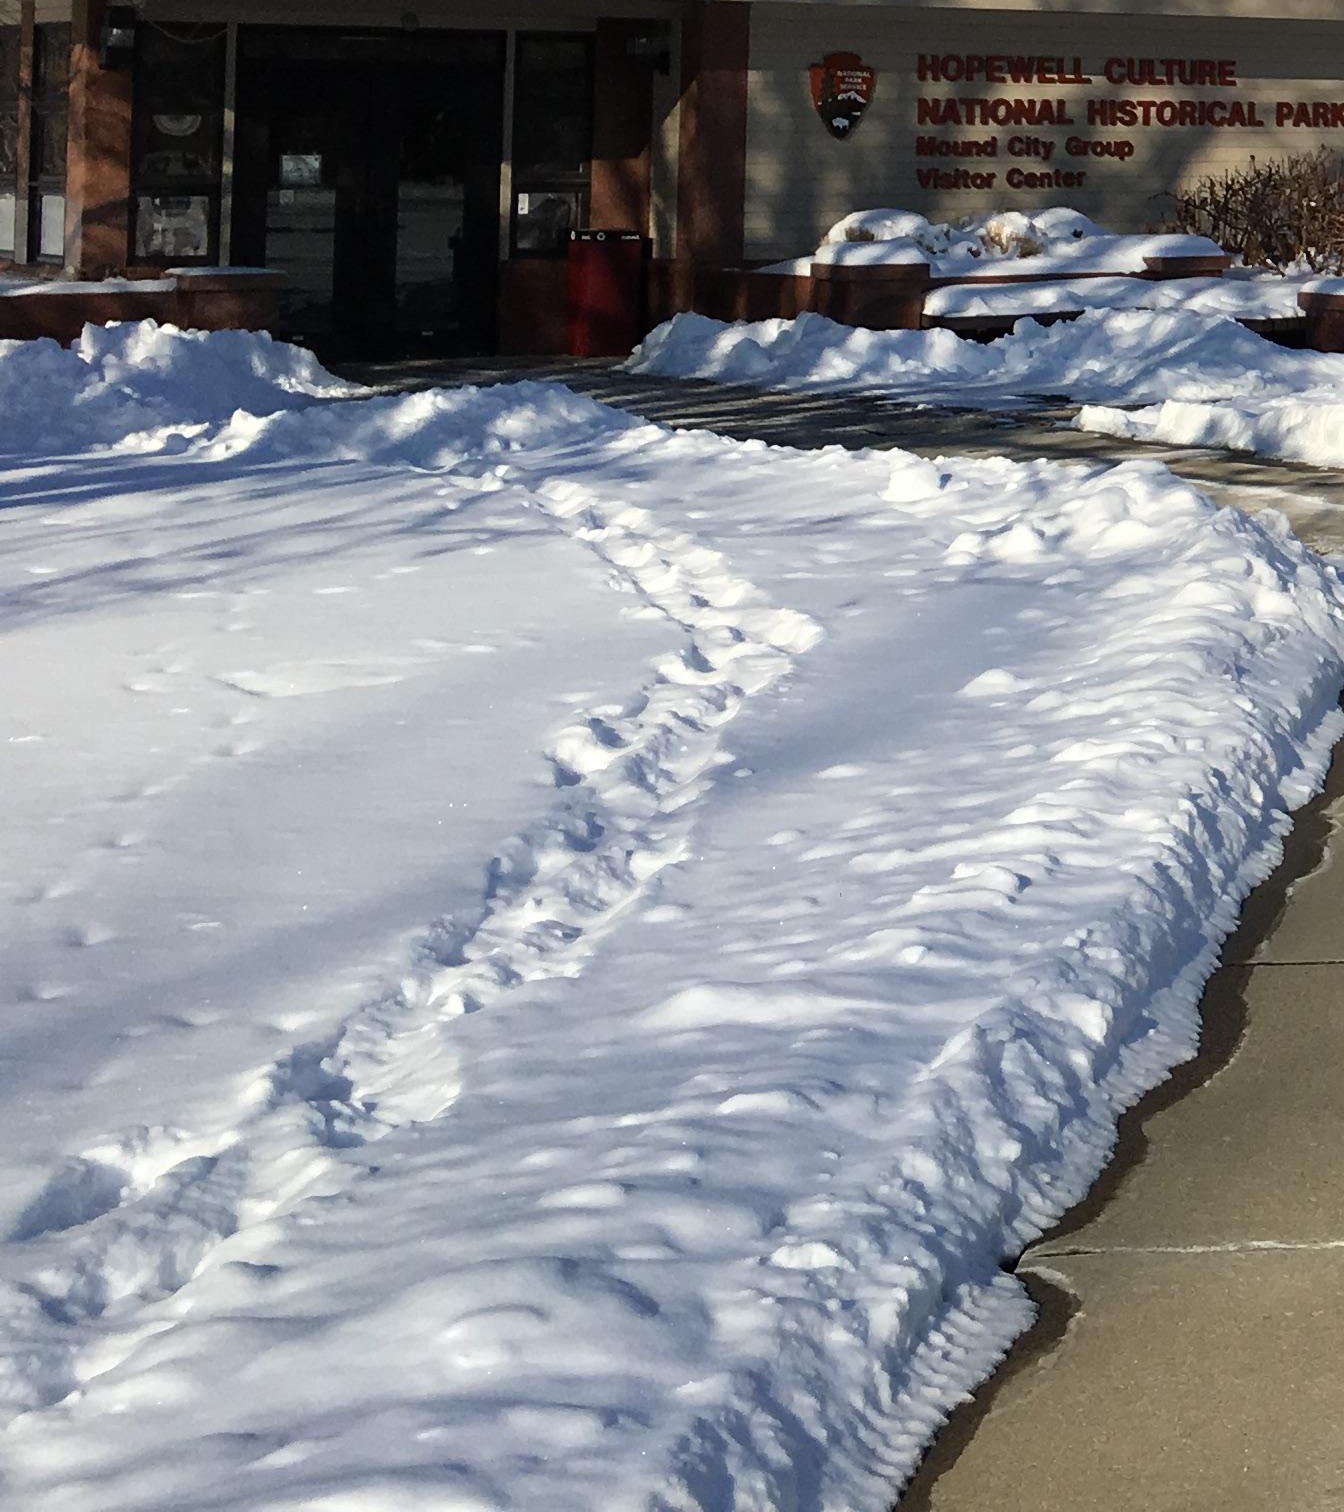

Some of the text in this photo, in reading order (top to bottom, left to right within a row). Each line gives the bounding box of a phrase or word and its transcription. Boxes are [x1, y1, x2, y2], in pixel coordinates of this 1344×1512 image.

[917, 54, 1237, 86] HOPEWELL CULTURE
[917, 97, 1074, 126] NATIONAL
[1087, 99, 1264, 127] HISTORICAL
[915, 136, 1134, 161] Mound City Group
[916, 168, 1086, 189] Visitor Center
